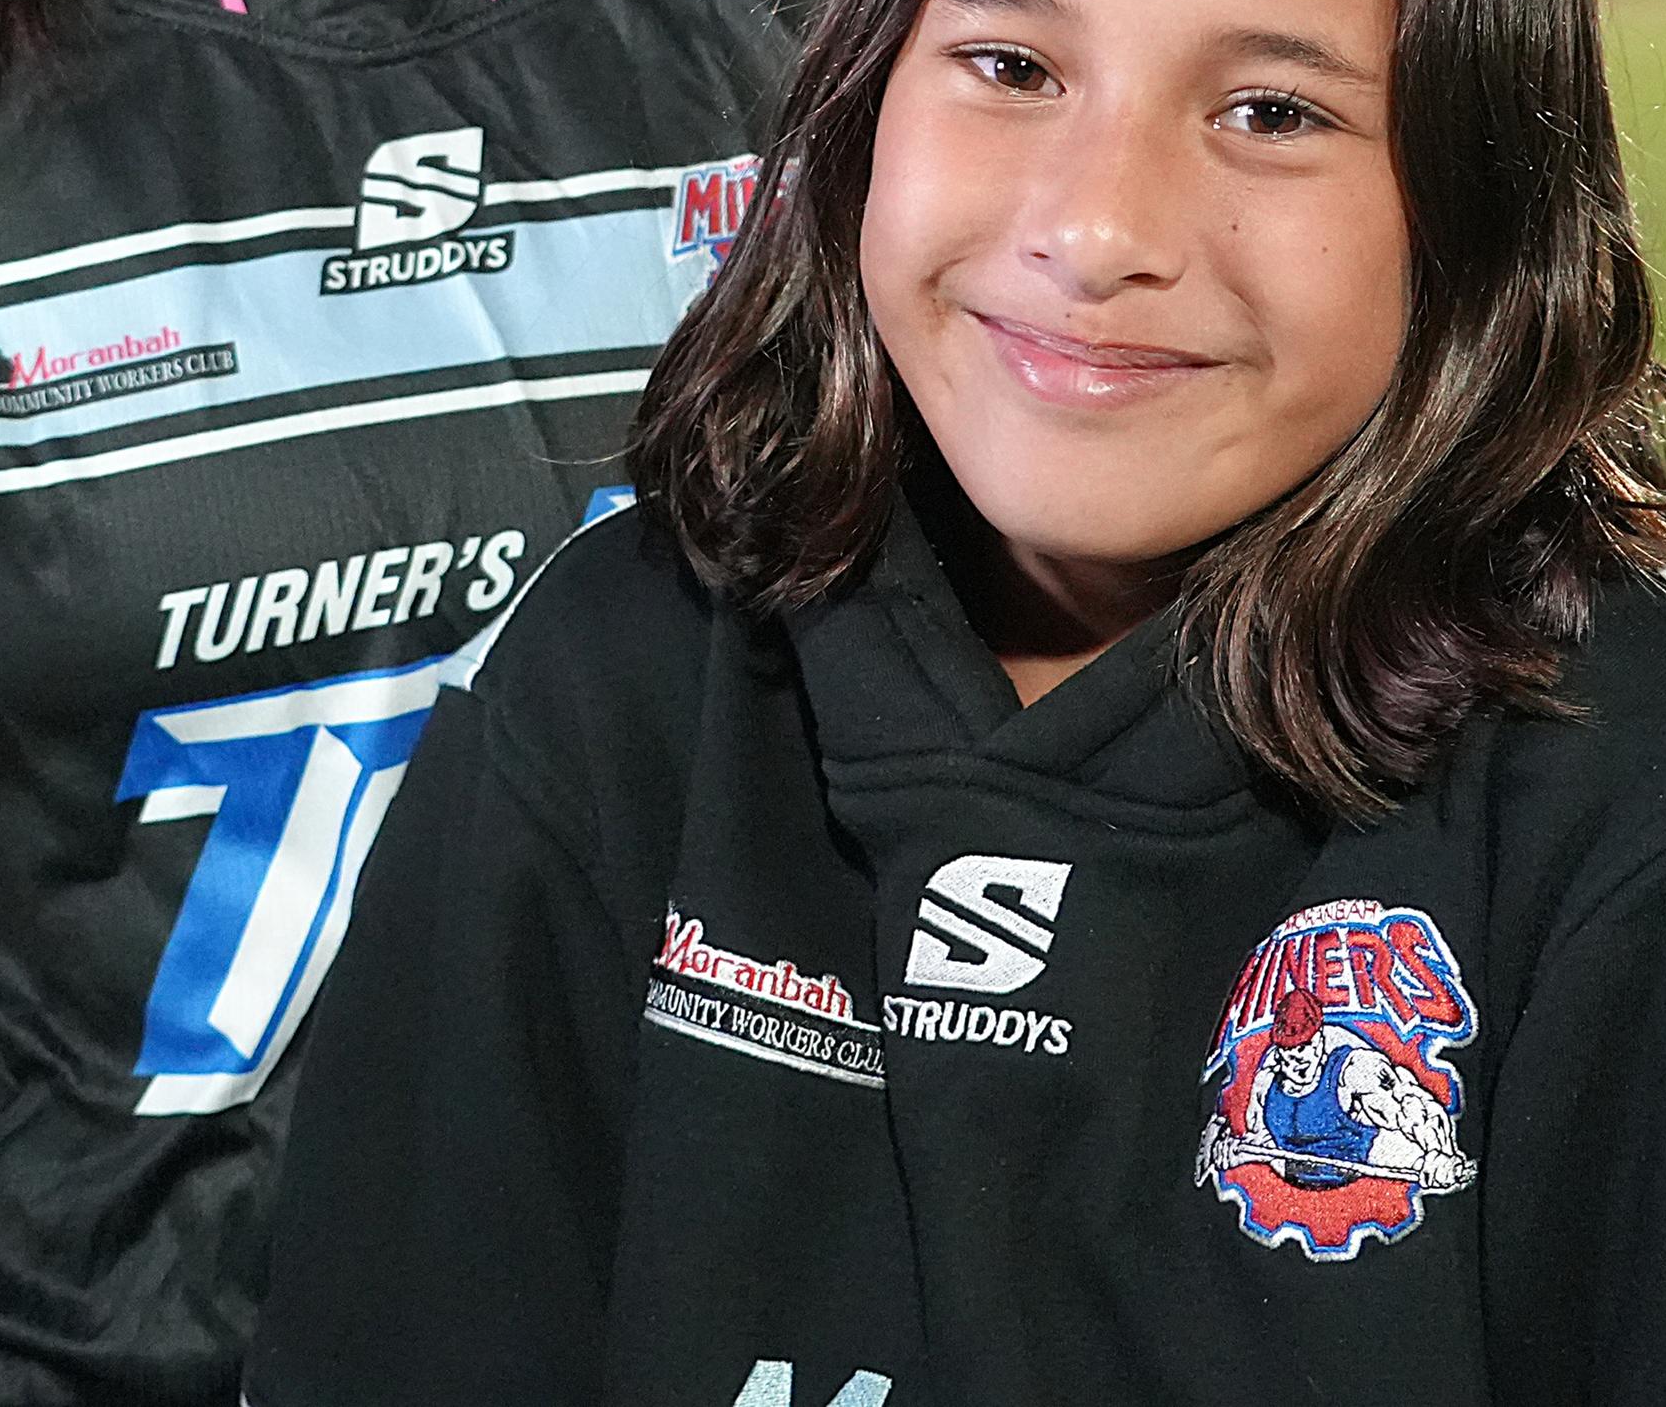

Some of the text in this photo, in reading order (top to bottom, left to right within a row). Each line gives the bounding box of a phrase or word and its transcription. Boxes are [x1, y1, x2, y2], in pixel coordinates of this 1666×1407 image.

[325, 238, 508, 291] STRUDDYS
[7, 327, 182, 390] Moranbah
[91, 360, 183, 394] WORKERS
[183, 349, 234, 375] CLUB
[155, 529, 526, 670] TURNER'S
[655, 919, 848, 1018] Moranbah
[1209, 921, 1464, 1052] MINERS
[731, 1005, 836, 1061] WORKERS
[883, 995, 1073, 1055] STRUDDYS
